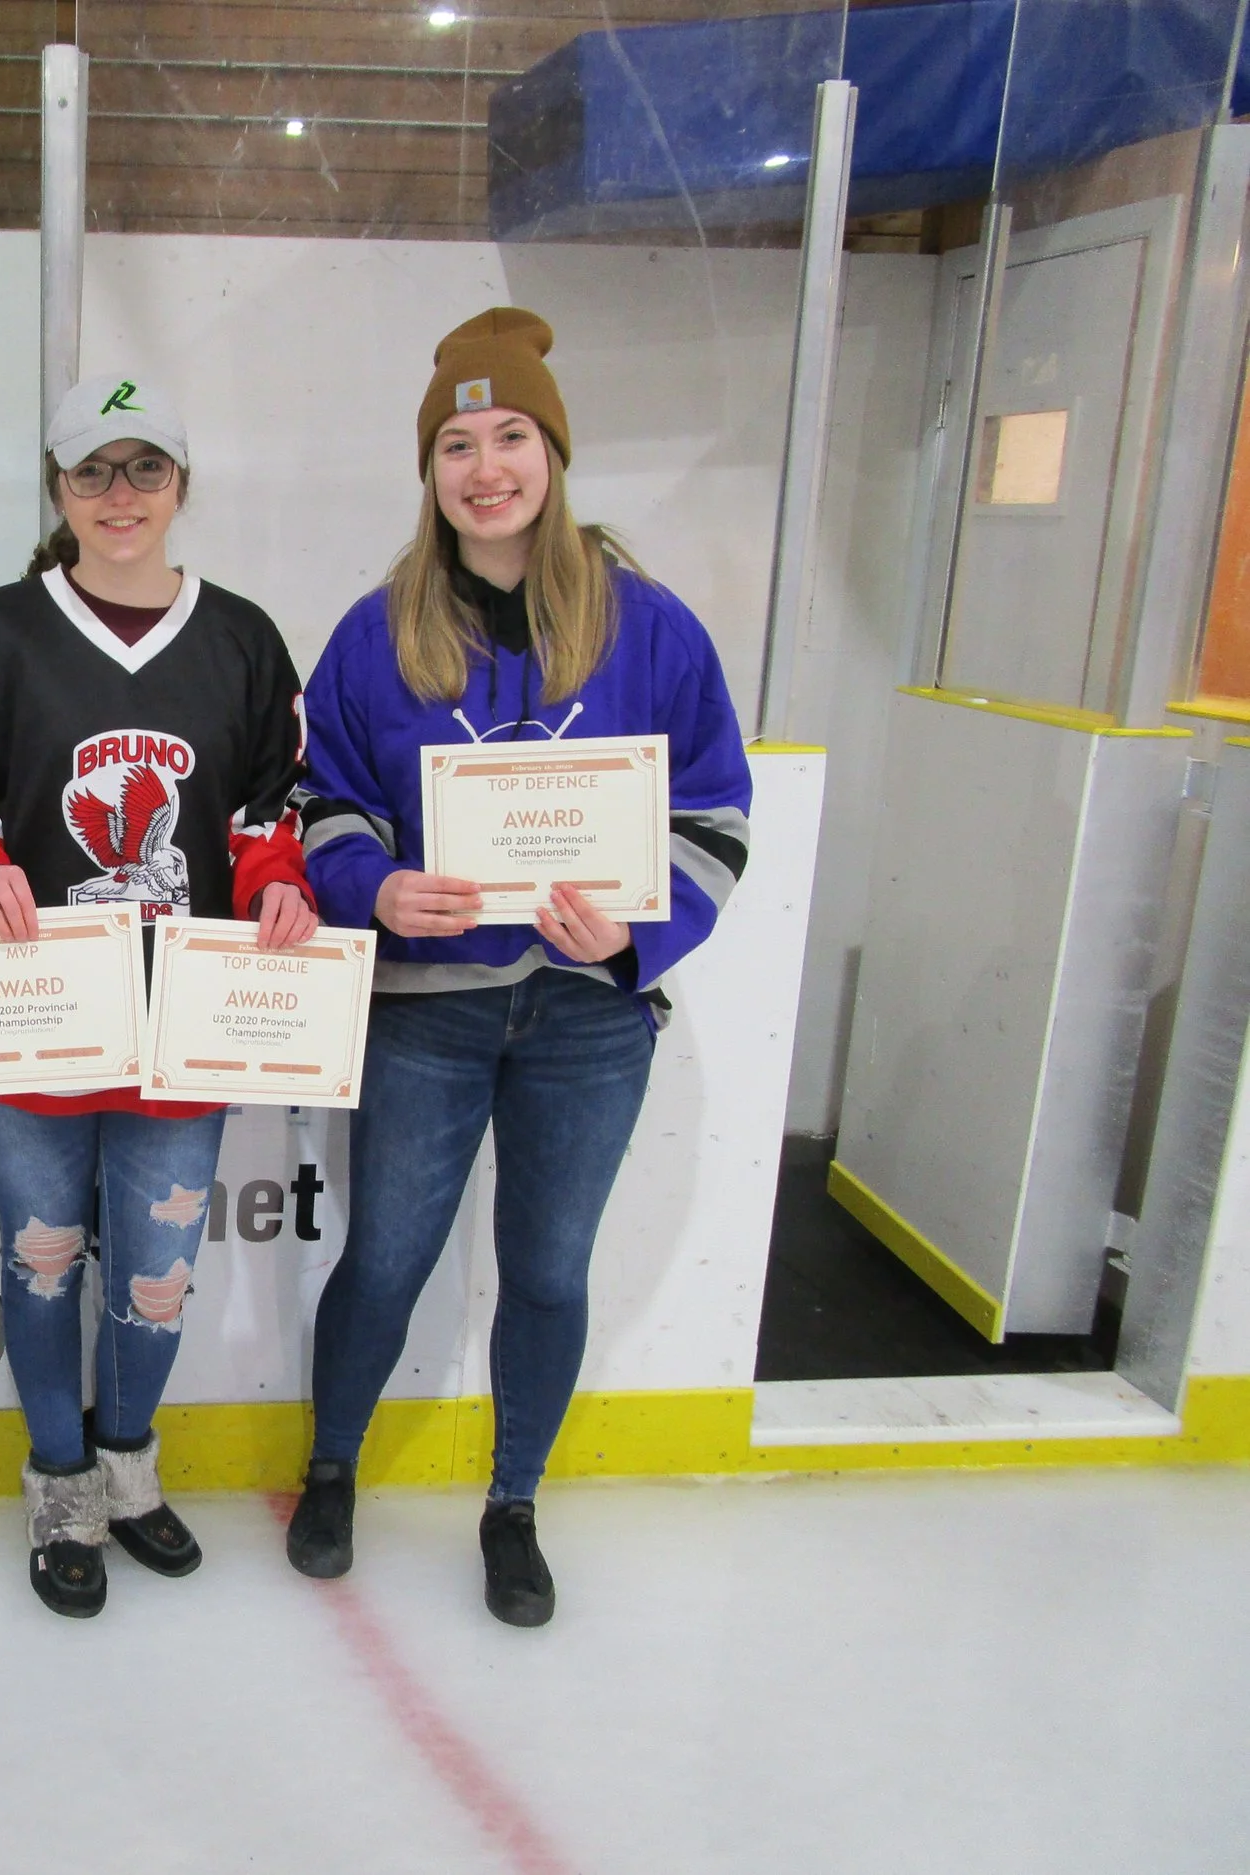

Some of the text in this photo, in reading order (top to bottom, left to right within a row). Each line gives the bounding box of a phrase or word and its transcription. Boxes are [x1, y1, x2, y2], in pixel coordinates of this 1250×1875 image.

[78, 735, 189, 778] BRUNO
[488, 775, 599, 791] TOP DEFENCE
[503, 808, 584, 829] AWARD
[491, 834, 597, 846] U20 2020 Provincial
[507, 848, 581, 858] Championship
[6, 945, 39, 959] MVP
[222, 956, 310, 974] TOP GOALIE
[225, 990, 299, 1011] AWARD
[0, 1005, 25, 1015] 2020
[27, 1002, 78, 1013] Provincial
[212, 1014, 307, 1028] U20 2020 Provincial
[225, 1027, 291, 1040] Championship
